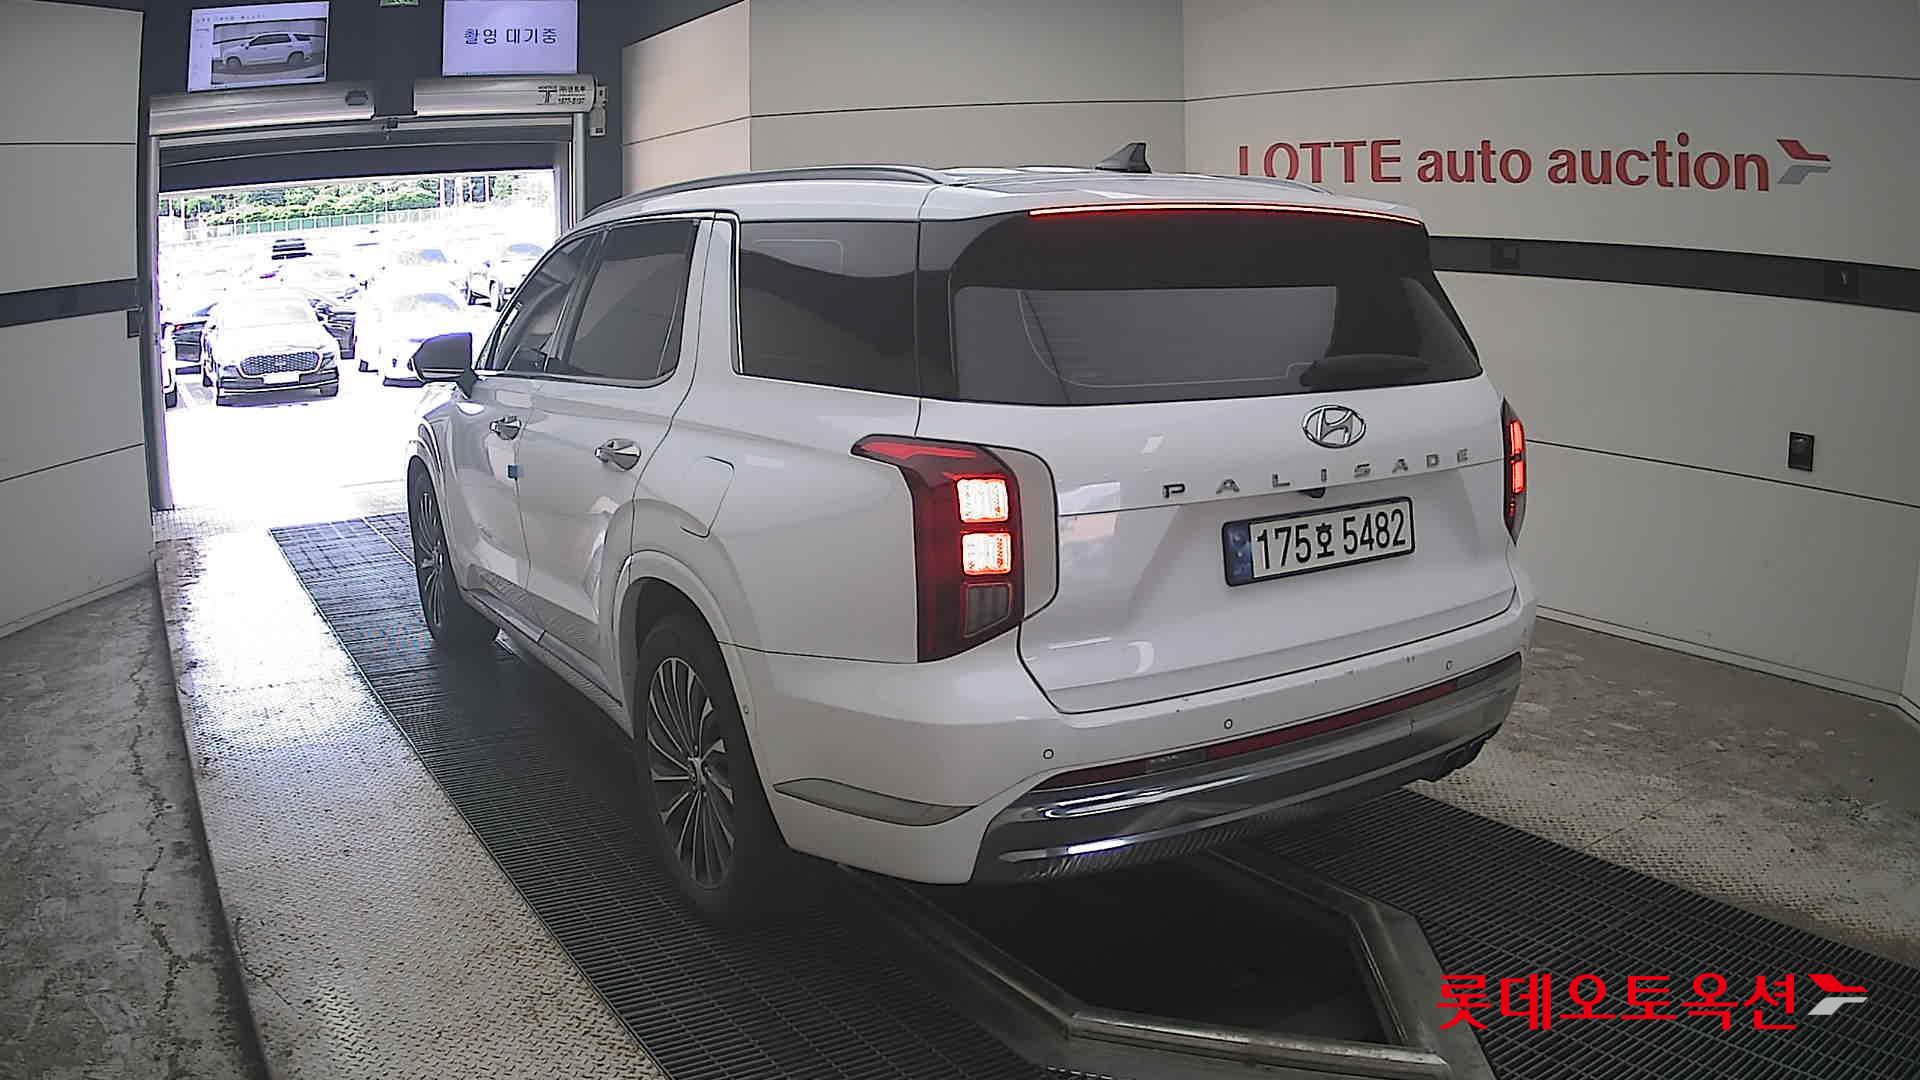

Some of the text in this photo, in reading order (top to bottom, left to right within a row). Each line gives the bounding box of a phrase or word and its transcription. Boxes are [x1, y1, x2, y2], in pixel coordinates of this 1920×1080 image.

[464, 28, 558, 45] 촬영 대기중
[1418, 139, 1532, 184] auto
[1548, 132, 1770, 192] auction
[1161, 447, 1470, 498] PALISADE
[1256, 508, 1406, 570] 175호 5482
